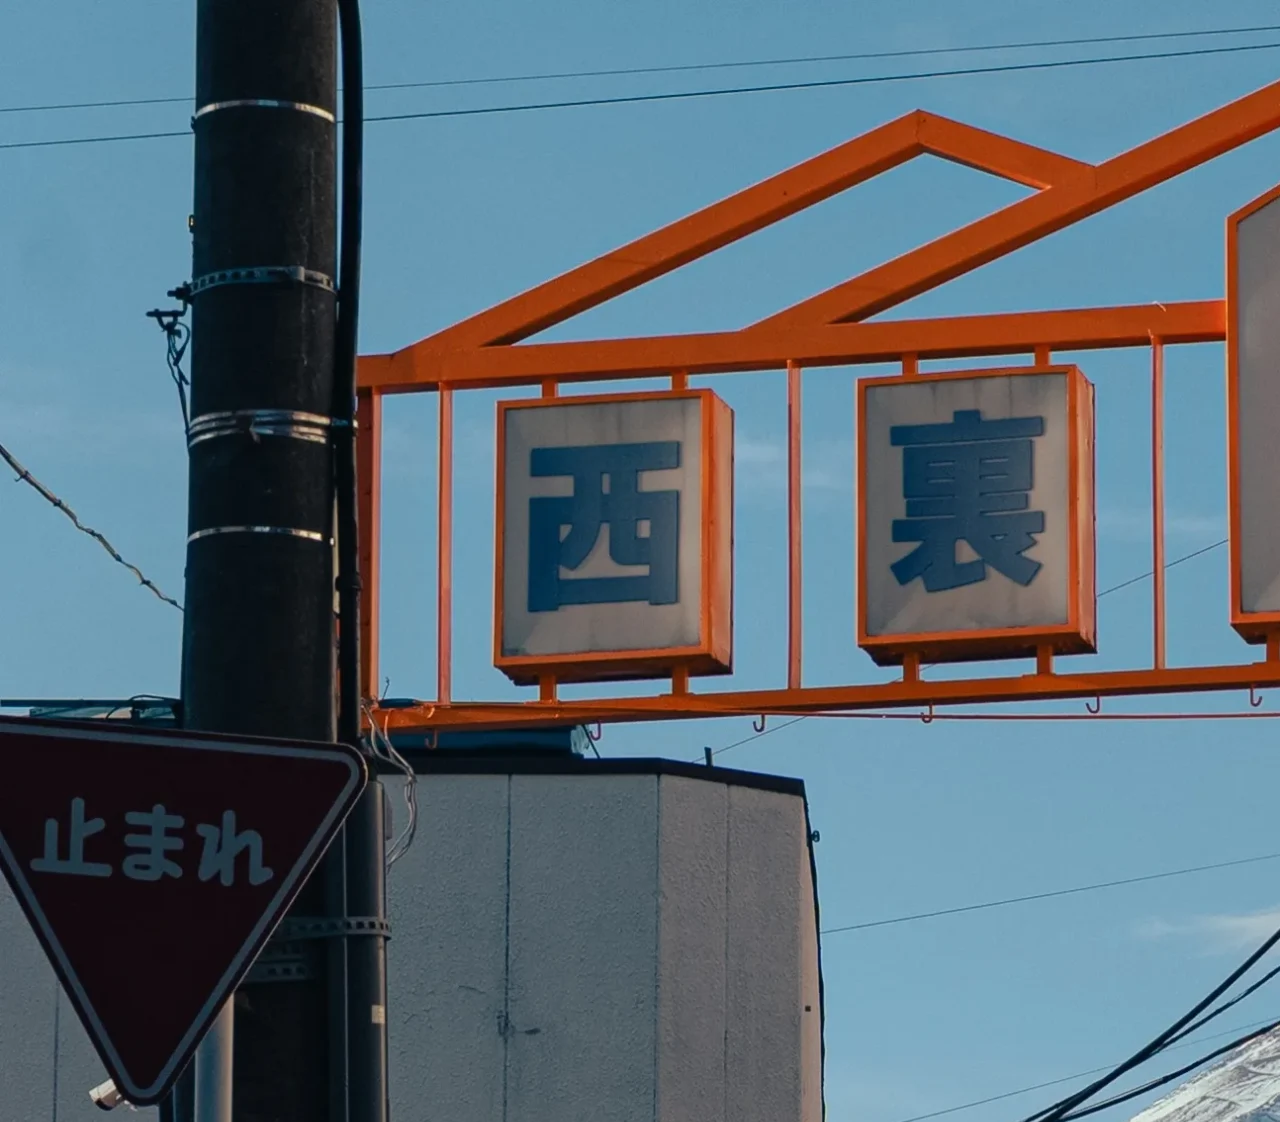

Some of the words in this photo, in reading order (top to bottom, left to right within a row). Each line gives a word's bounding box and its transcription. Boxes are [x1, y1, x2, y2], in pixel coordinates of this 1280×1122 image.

[527, 440, 680, 612] 西
[890, 410, 1044, 593] 裏
[30, 797, 274, 887] 止まれ
